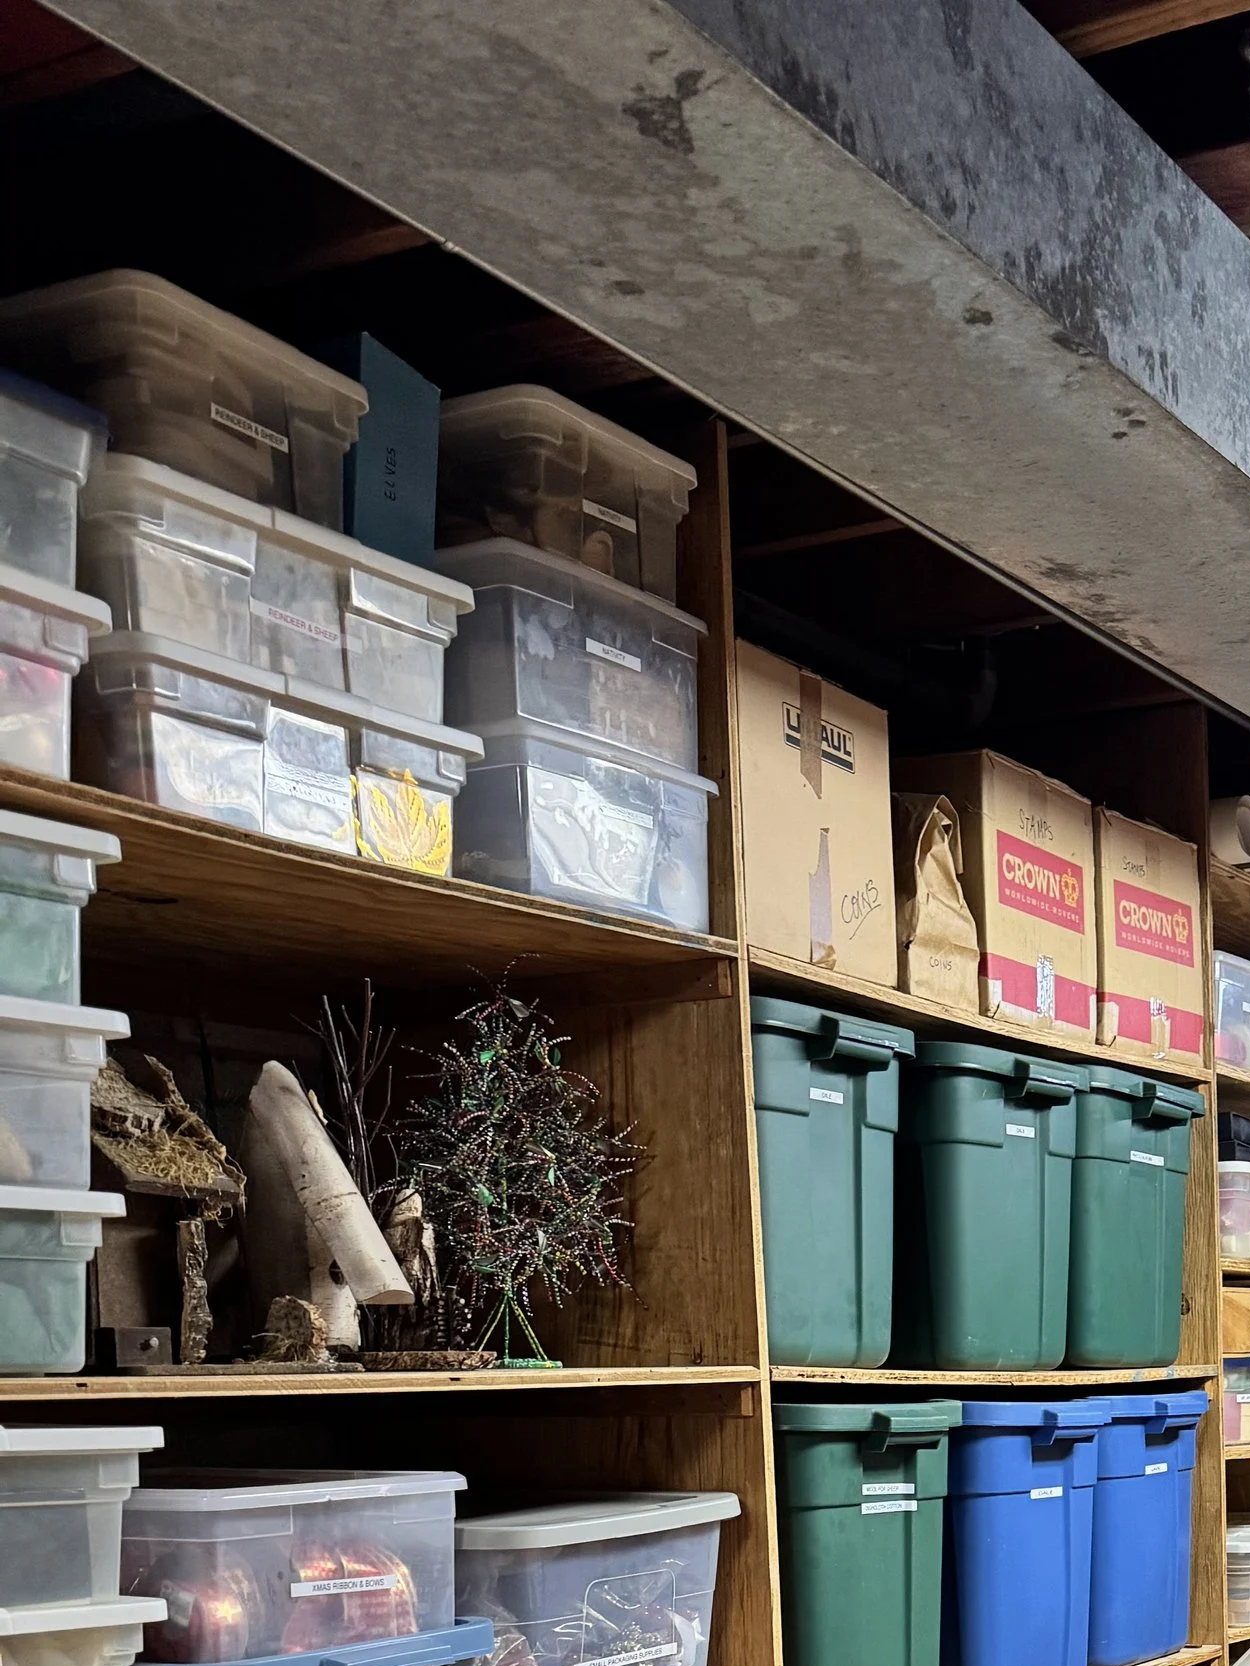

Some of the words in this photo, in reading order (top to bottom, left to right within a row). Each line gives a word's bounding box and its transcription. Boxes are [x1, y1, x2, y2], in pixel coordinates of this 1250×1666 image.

[215, 407, 254, 433] REINDEER
[254, 425, 260, 436] &
[260, 428, 285, 445] SHEEP
[384, 447, 396, 502] ELVES
[268, 608, 306, 630] REINDEER
[307, 624, 312, 633] &
[313, 627, 338, 642] SHEEP
[1019, 809, 1054, 841] STAMPS
[1002, 852, 1061, 901] CROWN
[1004, 887, 1051, 913] WORLDWIDE
[1119, 900, 1173, 939] CROWN
[1120, 931, 1164, 950] WORLDWIDE
[928, 955, 953, 971] COINS
[312, 1583, 332, 1593] XMAS
[333, 1581, 358, 1590] RIBBON
[360, 1580, 364, 1588] &
[366, 1579, 385, 1587] BOWS
[608, 1654, 638, 1666] PACKAGING
[639, 1648, 663, 1658] SUPPLIES
